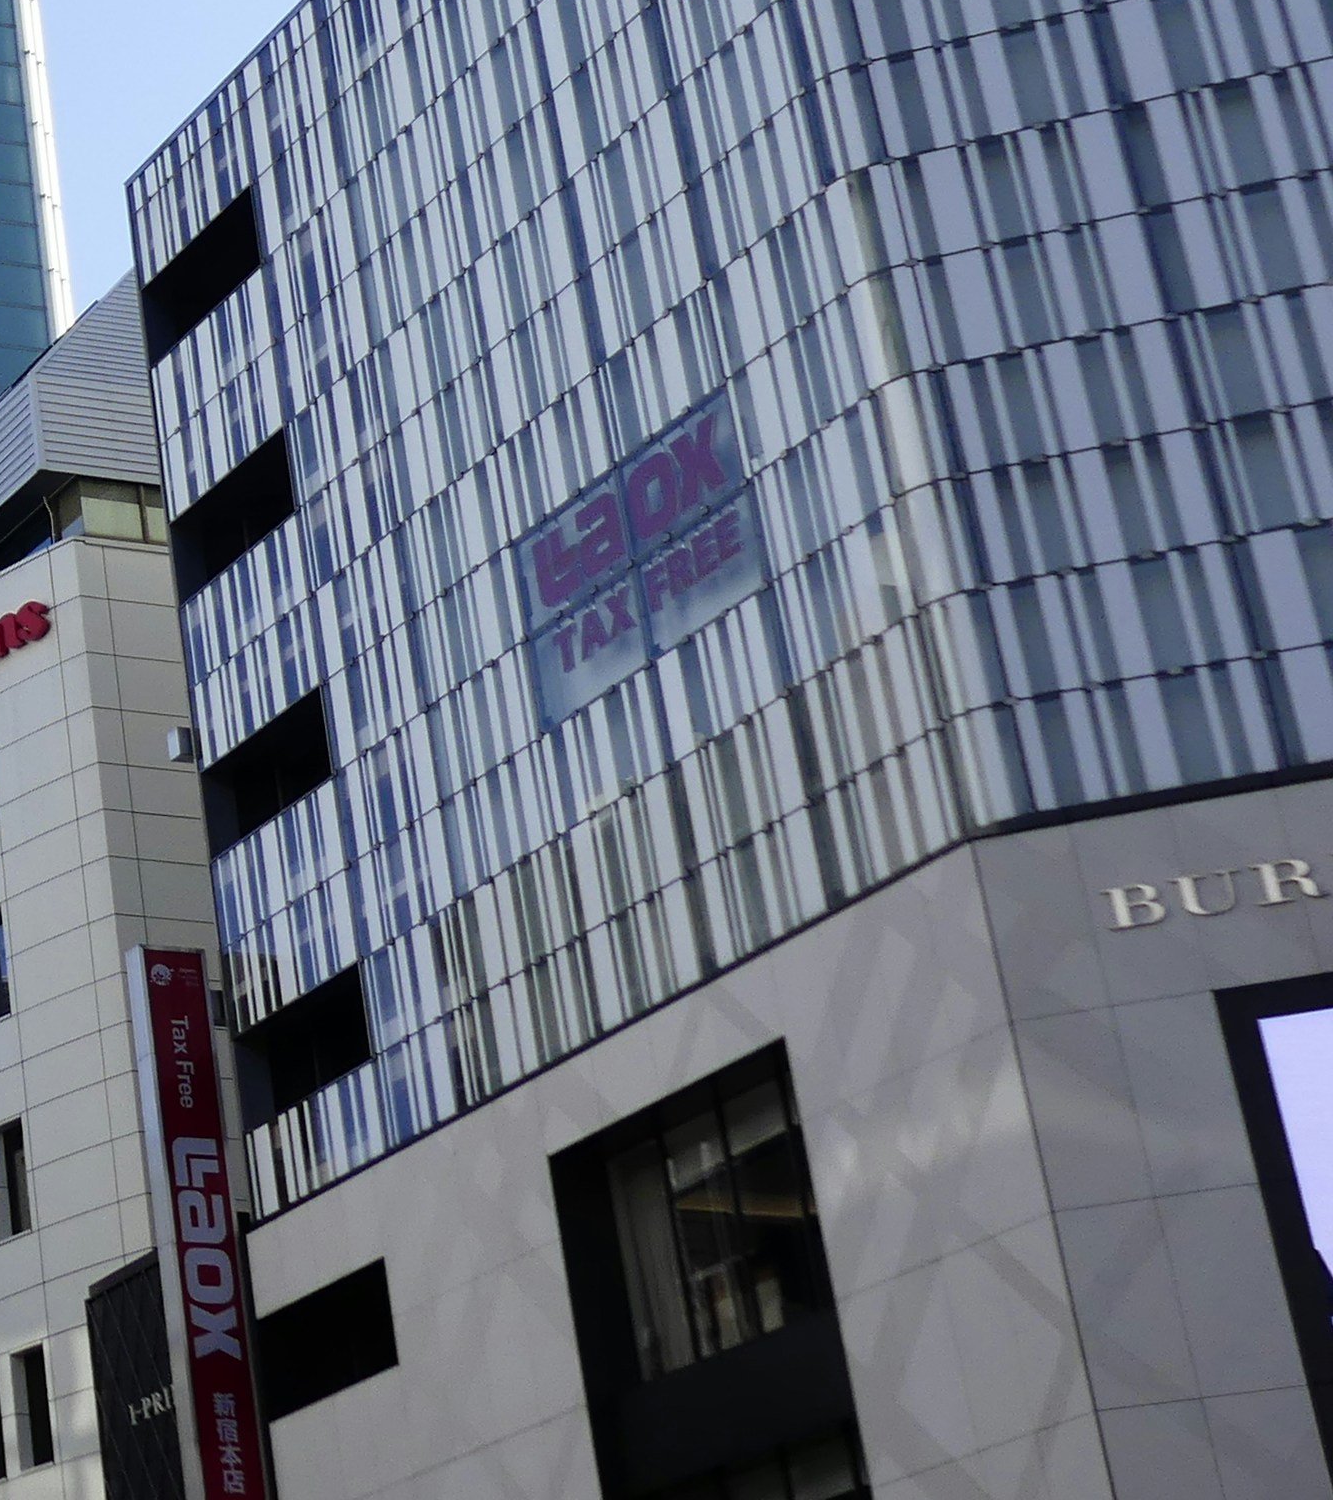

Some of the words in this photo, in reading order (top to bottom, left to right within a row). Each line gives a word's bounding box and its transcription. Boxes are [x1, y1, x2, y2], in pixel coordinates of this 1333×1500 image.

[552, 584, 638, 674] TAX
[641, 506, 744, 612] FREE
[1100, 854, 1333, 932] BUR
[170, 1015, 190, 1055] Tax
[175, 1059, 196, 1109] Free
[128, 1384, 175, 1425] I-PRI
